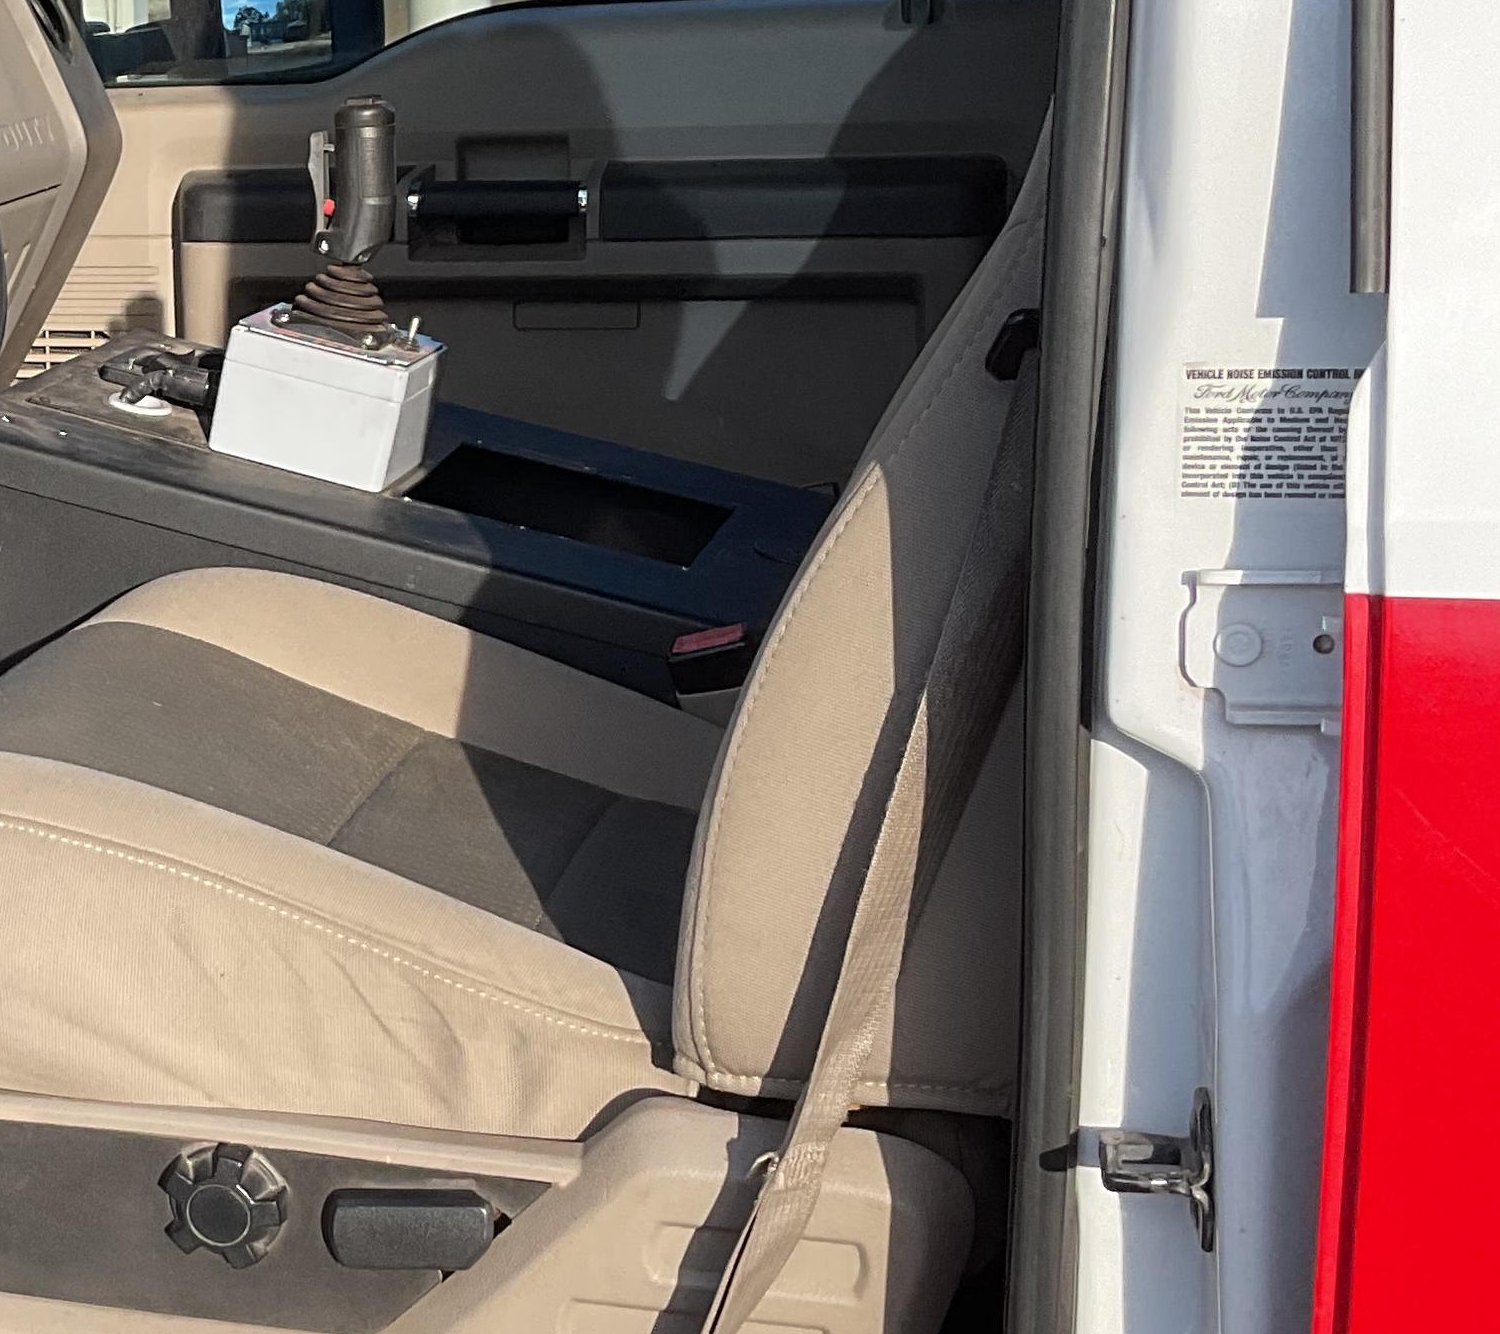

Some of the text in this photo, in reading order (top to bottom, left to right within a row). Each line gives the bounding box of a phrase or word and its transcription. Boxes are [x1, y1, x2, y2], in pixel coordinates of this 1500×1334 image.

[1186, 369, 1224, 379] VEHICLE
[1227, 369, 1254, 379] NOISE
[1258, 369, 1303, 379] EMISSION
[1307, 369, 1351, 379] CONTROL
[1194, 384, 1235, 399] Ford
[1226, 384, 1281, 403] Motor
